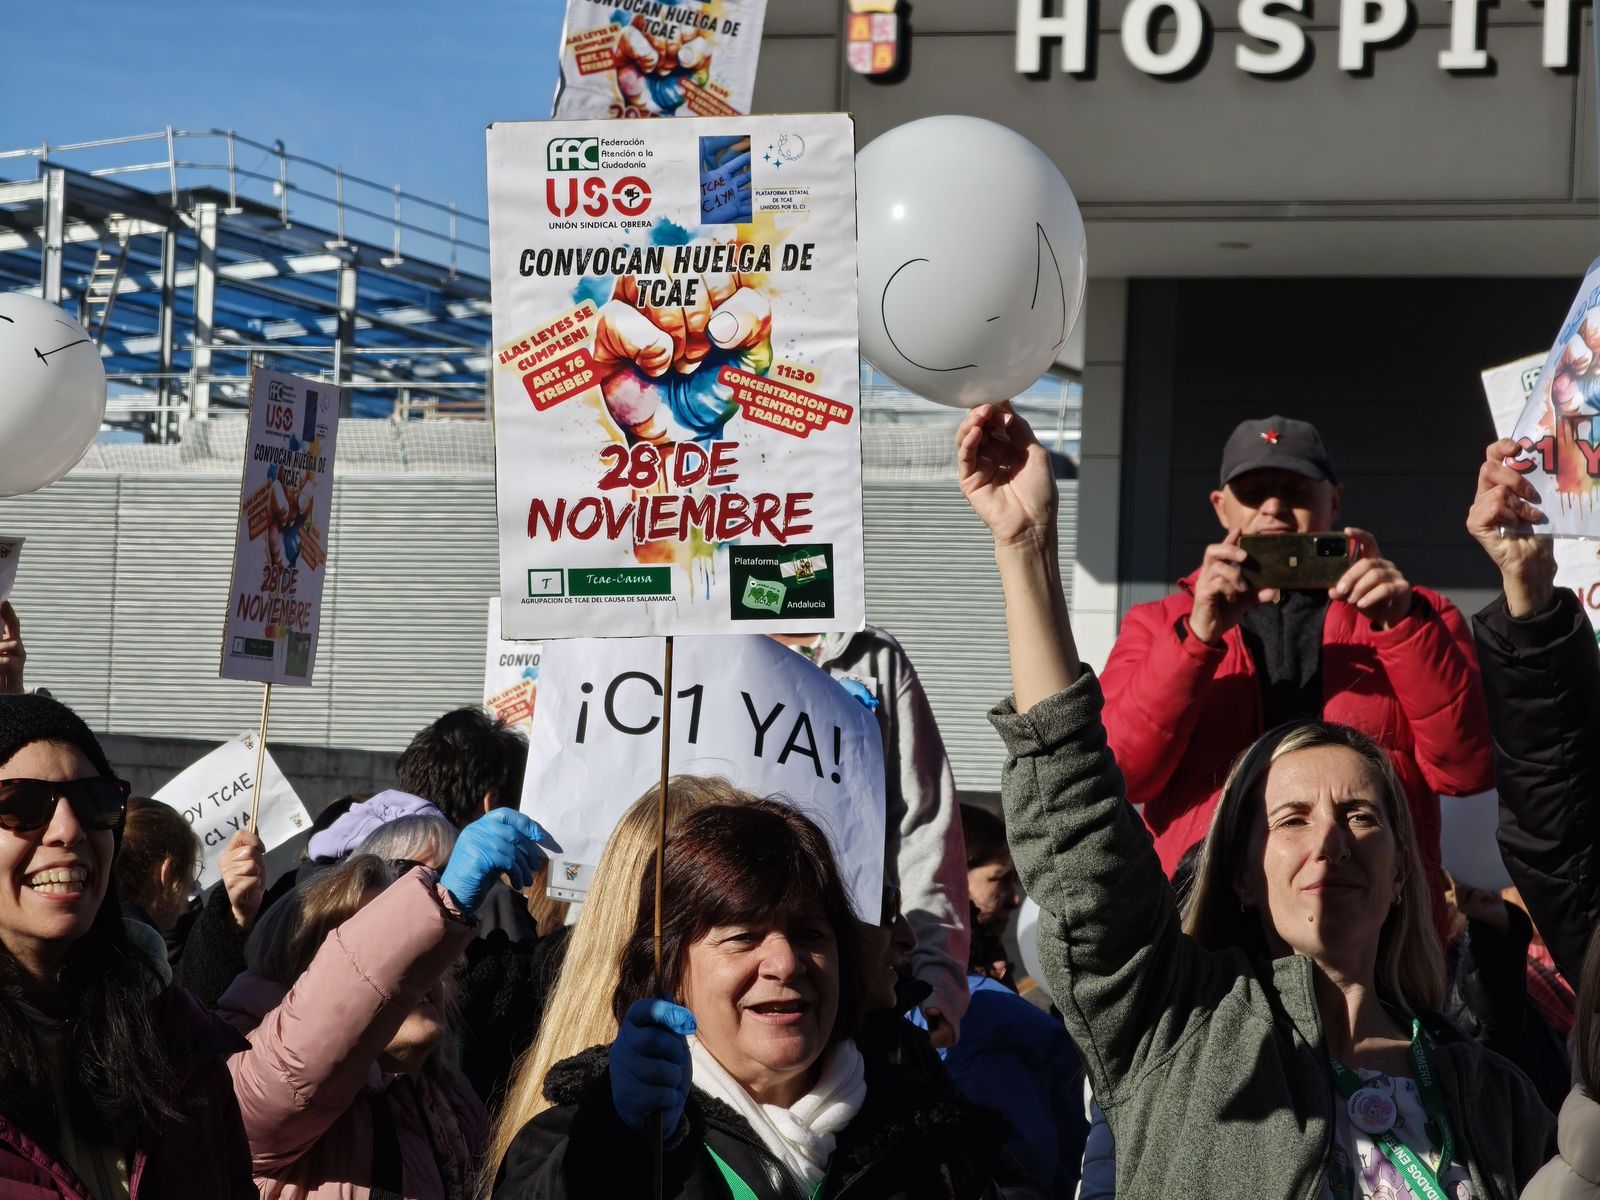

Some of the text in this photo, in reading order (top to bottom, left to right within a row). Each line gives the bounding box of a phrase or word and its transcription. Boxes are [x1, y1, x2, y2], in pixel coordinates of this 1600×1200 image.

[585, 0, 741, 37] VOCAN HUELGA DE
[643, 19, 678, 41] TCAE
[1015, 0, 1570, 75] HOSPIT
[601, 138, 645, 146] Federación
[601, 161, 646, 169] Ciudadanía
[546, 176, 652, 218] USO
[700, 176, 725, 196] TCAE
[549, 220, 652, 229] UNIÓN SINDICAL OBRERA
[519, 242, 816, 277] CONVOCAN HUELGA DE
[636, 278, 699, 308] TCAE
[498, 305, 594, 365] ¡LAS LEYES SE
[517, 326, 589, 371] CUMPLEN!
[532, 355, 586, 390] ART. 76
[535, 369, 594, 404] TREBEP
[776, 364, 815, 384] 11:30
[723, 371, 848, 419] CONCENTRACION EN
[738, 389, 824, 425] EL CENTRO DE
[266, 403, 293, 431] USO
[748, 406, 806, 433] TRABAJO
[254, 443, 293, 467] CONVOCAN
[317, 456, 327, 474] DE
[597, 441, 740, 490] 28 DE
[1504, 436, 1557, 475] C1
[284, 469, 299, 487] TCAE
[526, 492, 814, 544] NOVIEMBRE
[734, 557, 779, 566] Plataforma
[261, 565, 299, 594] 28 DE
[541, 577, 553, 590] T
[586, 573, 653, 585] Tcae-Causa
[236, 593, 312, 631] NOVIEMBRE
[787, 600, 826, 608] Andalucía
[499, 653, 540, 666] CONVO
[574, 670, 842, 785] ¡C1 YA!
[207, 772, 254, 807] TCAE
[204, 827, 226, 847] C1
